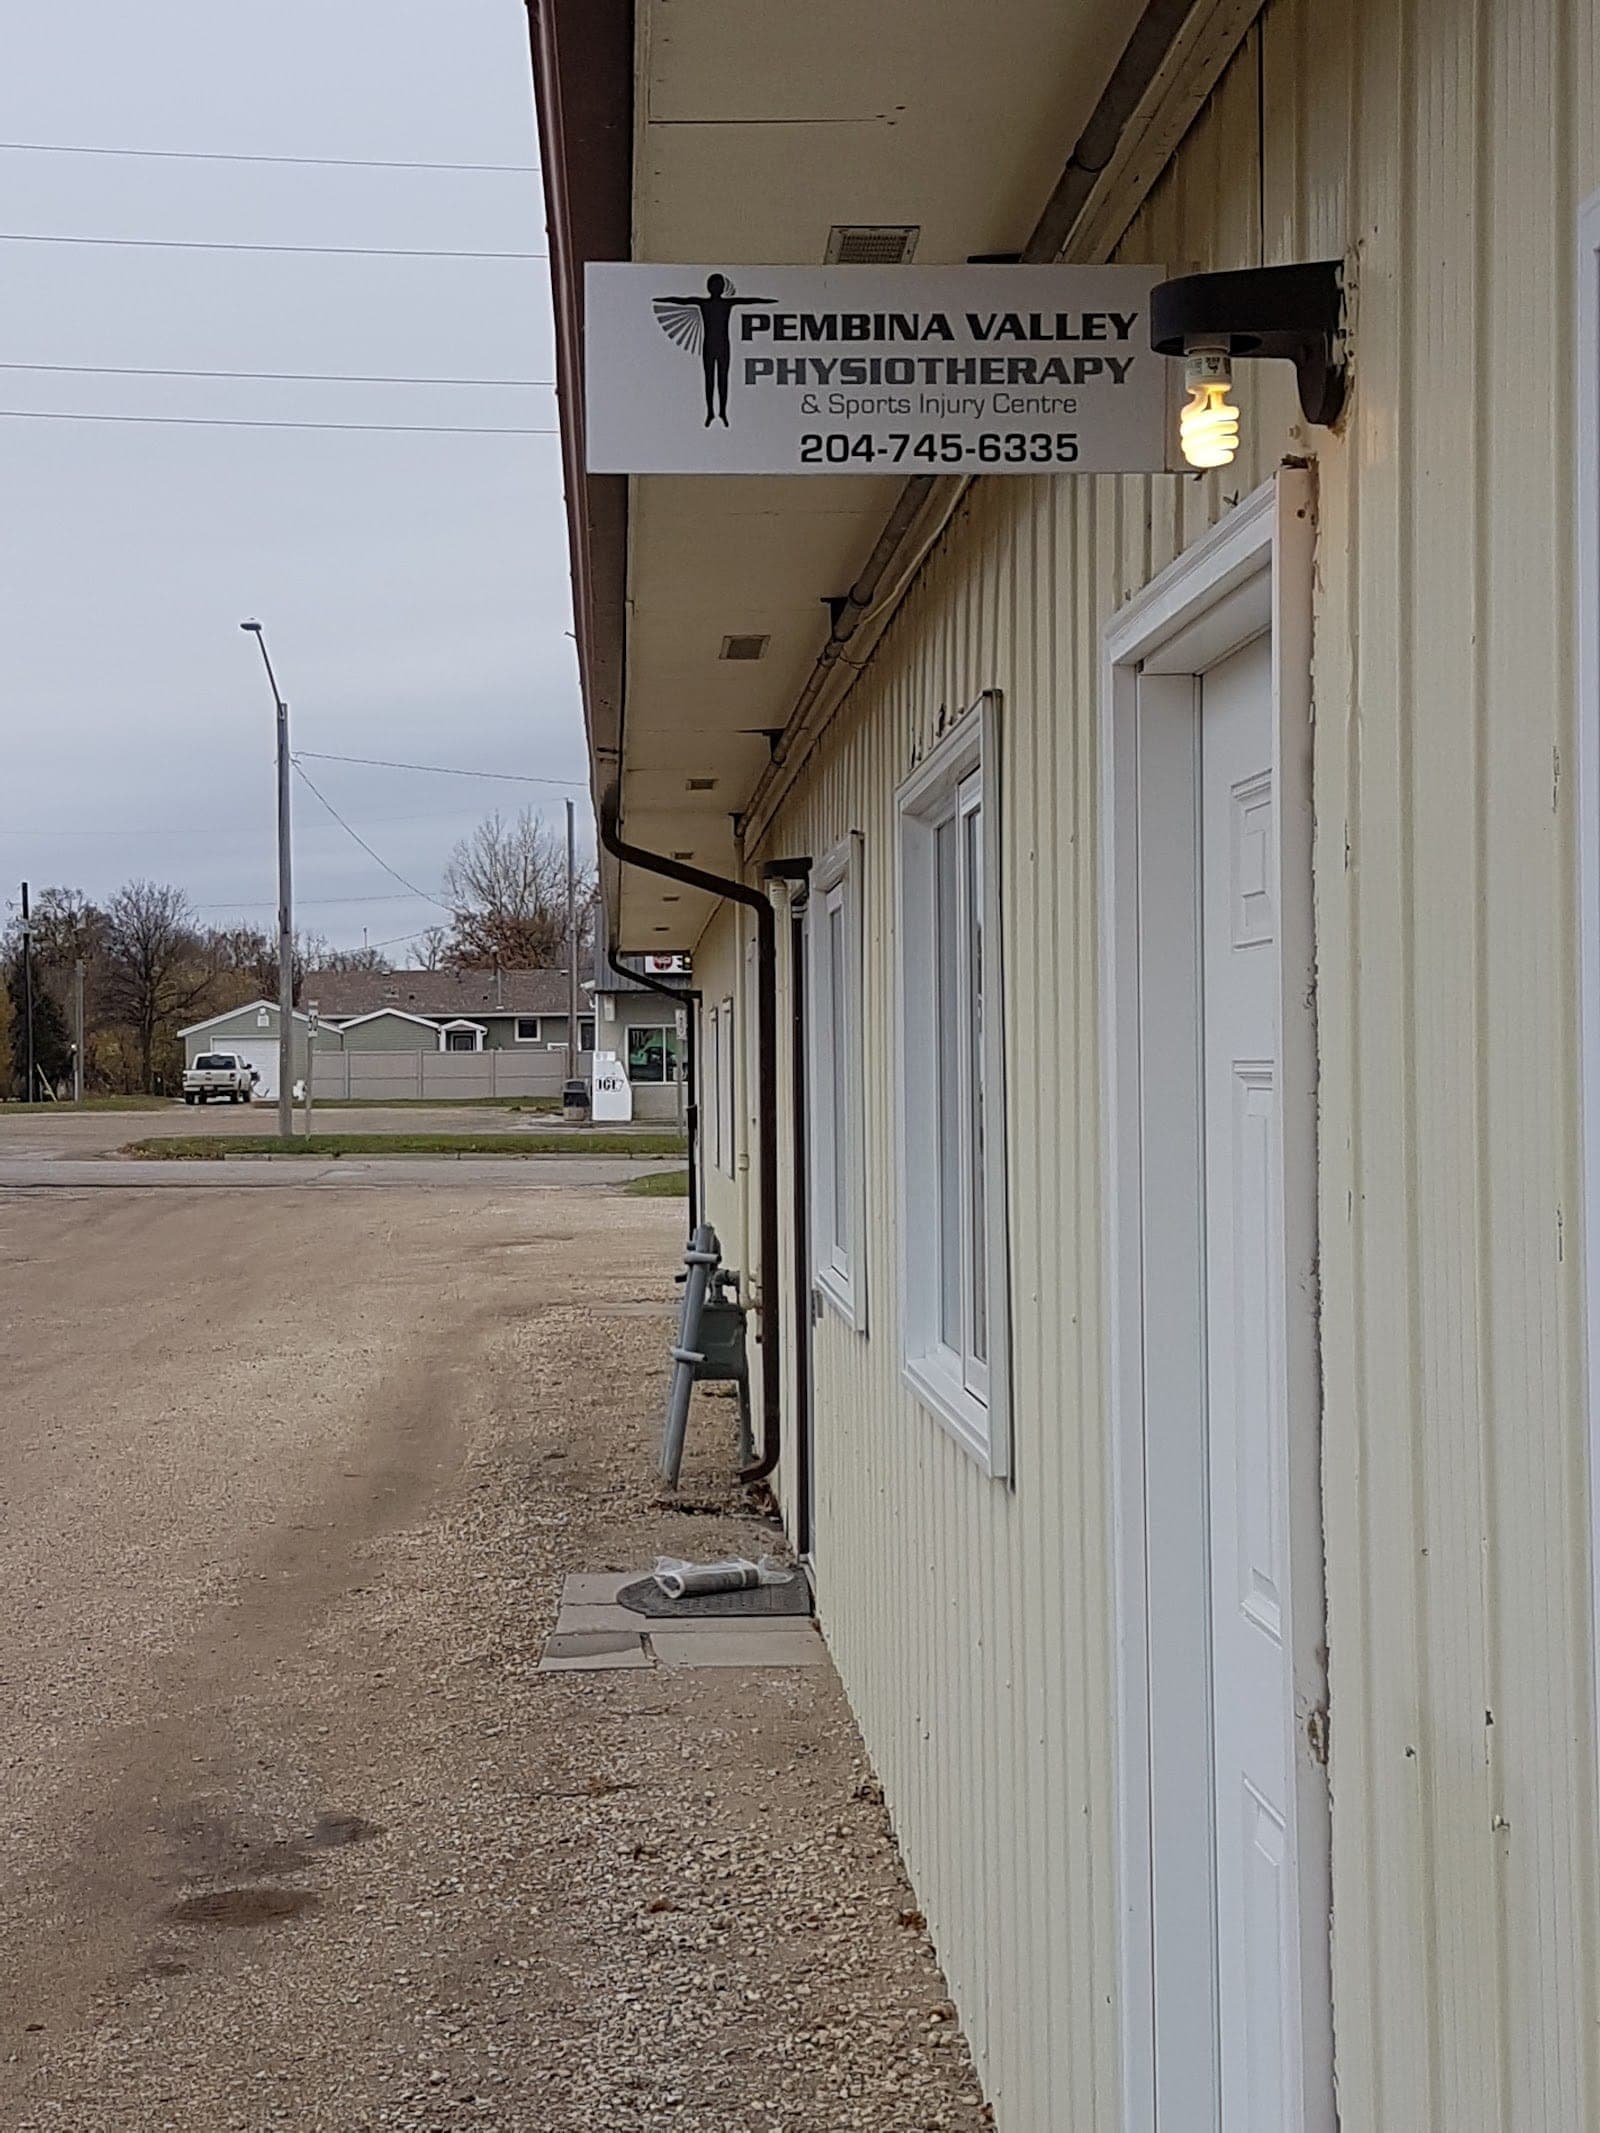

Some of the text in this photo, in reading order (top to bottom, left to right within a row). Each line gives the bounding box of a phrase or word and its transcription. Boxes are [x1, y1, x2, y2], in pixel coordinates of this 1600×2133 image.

[741, 312, 1139, 341] PEMBINA VALLEY
[744, 356, 1135, 385] PHYSIOTHERAPY
[800, 392, 1078, 420] & Sports Injury Centre
[800, 433, 1079, 463] 204-745-6335
